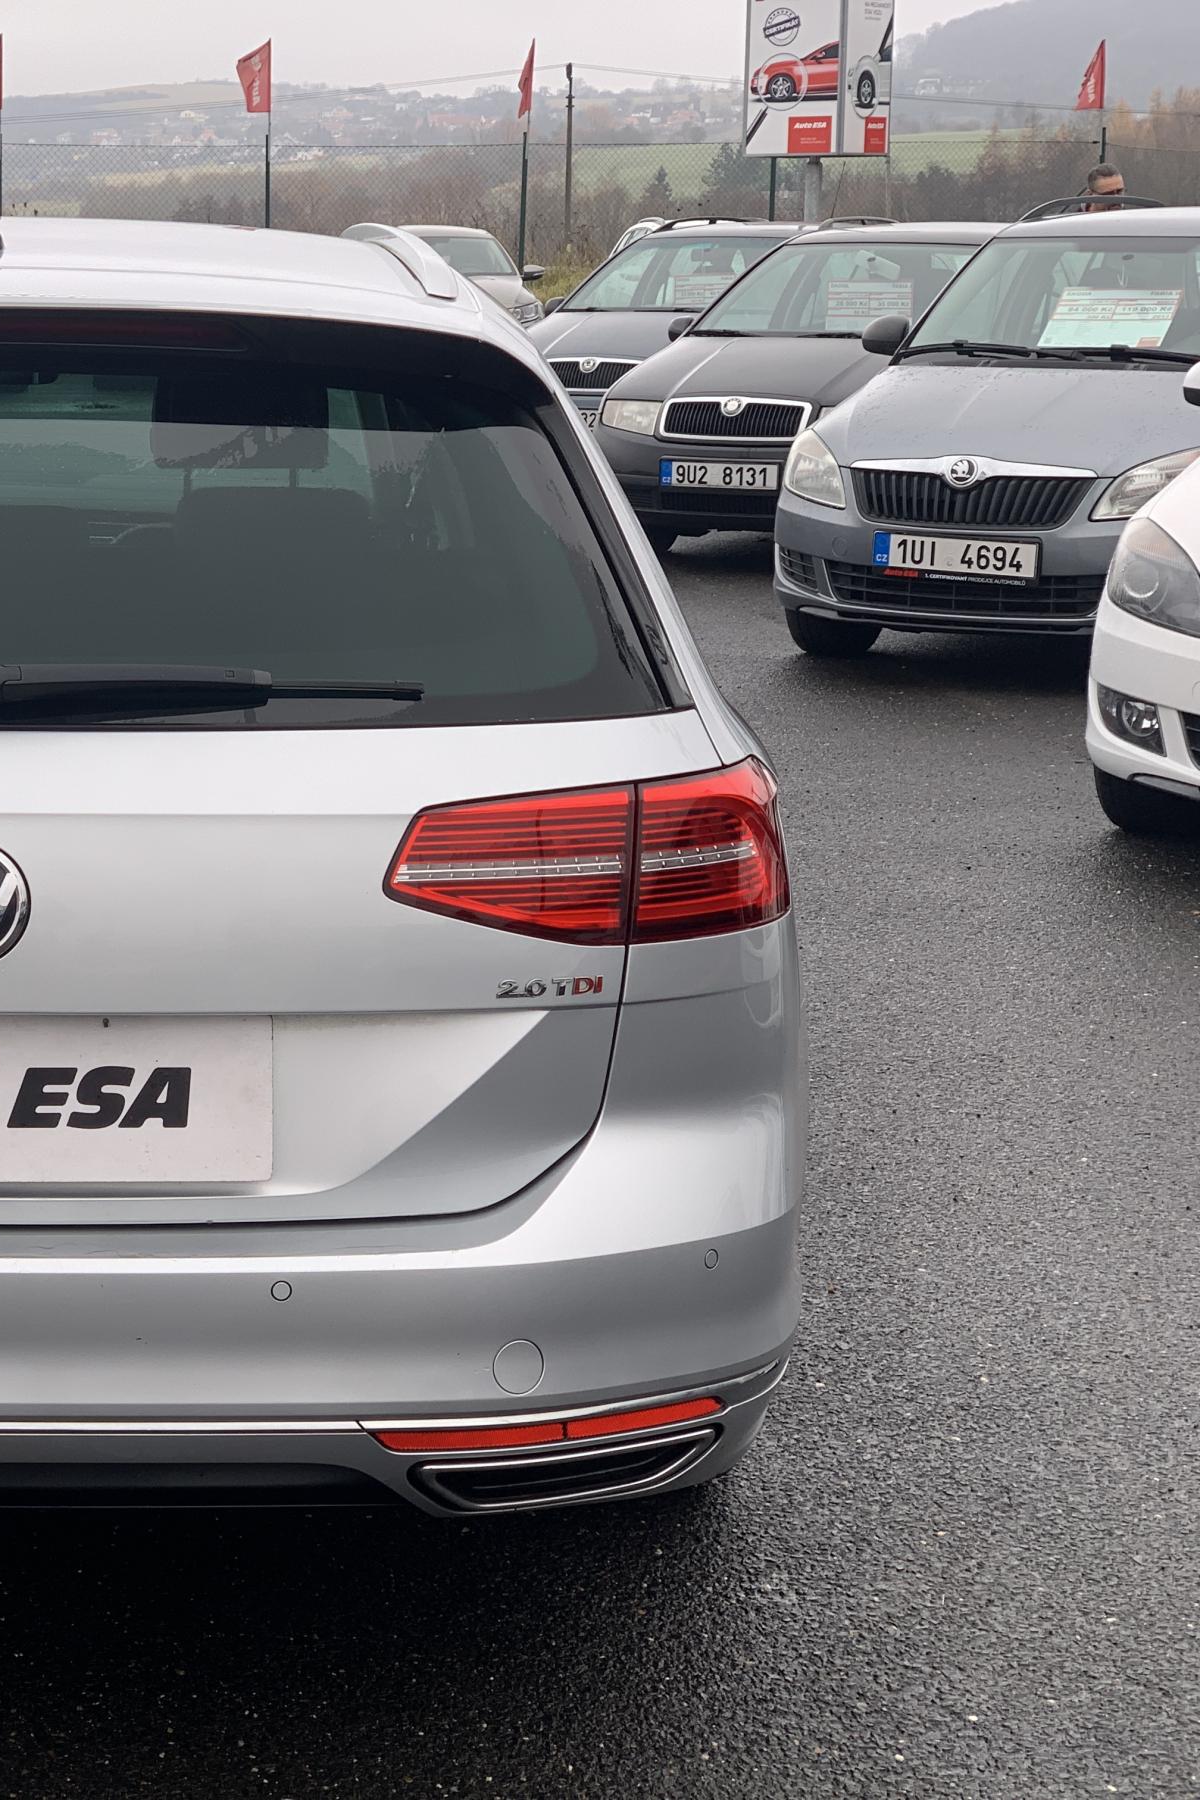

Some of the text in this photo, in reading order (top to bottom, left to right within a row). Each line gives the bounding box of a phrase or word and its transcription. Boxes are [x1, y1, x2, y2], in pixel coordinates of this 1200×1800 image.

[676, 465, 767, 487] 9U2 8131
[875, 553, 888, 563] CZ
[960, 543, 1022, 572] 4694
[552, 974, 604, 997] TDI
[6, 1065, 192, 1130] ESA
